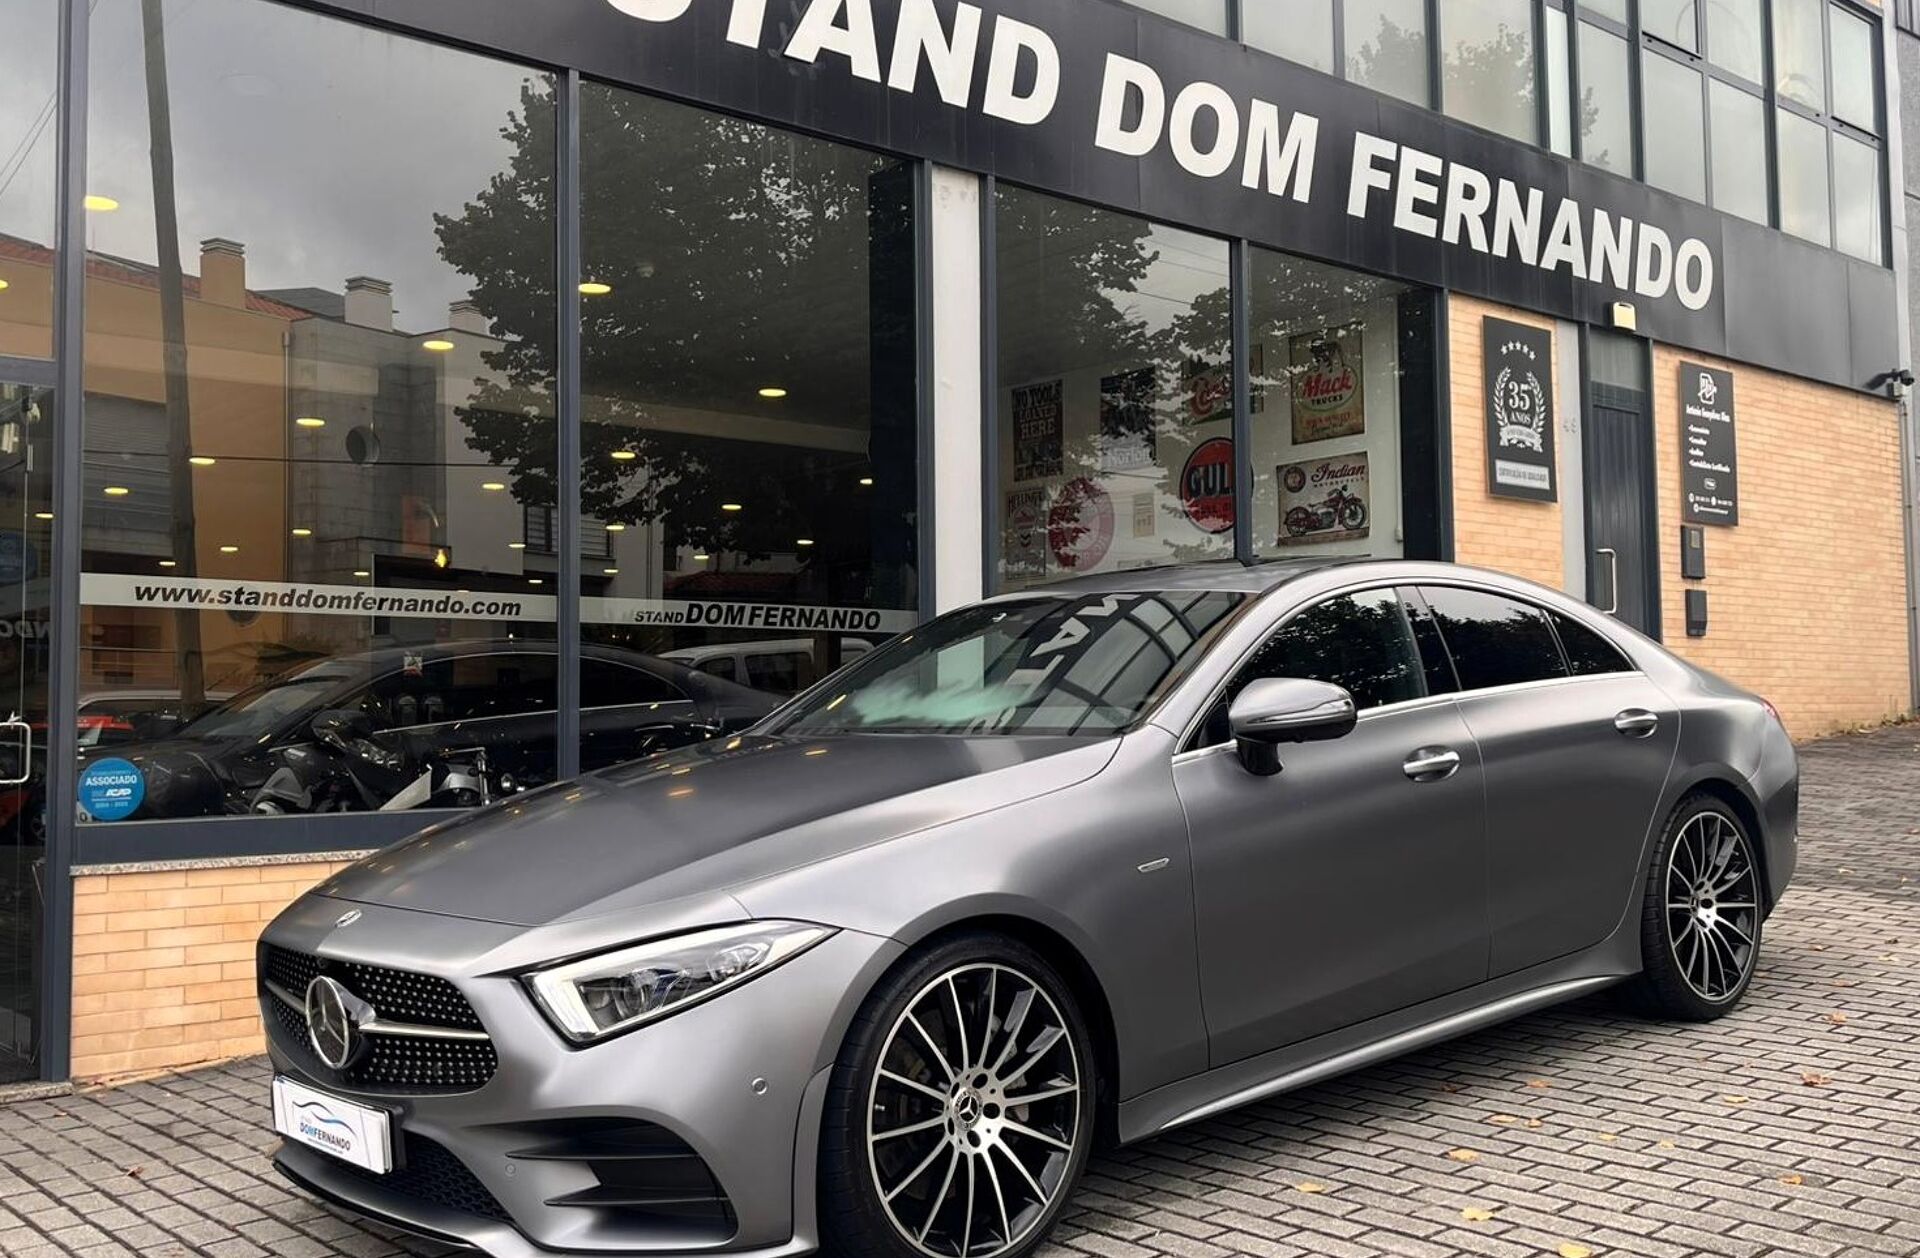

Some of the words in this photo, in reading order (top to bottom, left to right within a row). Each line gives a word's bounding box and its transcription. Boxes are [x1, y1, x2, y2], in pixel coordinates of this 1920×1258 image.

[1095, 52, 1319, 203] DOM
[1346, 131, 1713, 310] FERNANDO
[1303, 369, 1352, 398] Mack
[1508, 381, 1532, 410] 35
[1311, 393, 1343, 406] TRUCKS
[1188, 463, 1234, 499] GUL
[1311, 462, 1366, 483] Indian
[134, 585, 522, 617] www.standdomfernando.com
[634, 610, 684, 624] STAND
[685, 602, 745, 626] DOM
[748, 605, 881, 631] FERNANDO
[85, 774, 137, 787] ASSOCIADO
[300, 1122, 351, 1152] DOMFERNANDO
